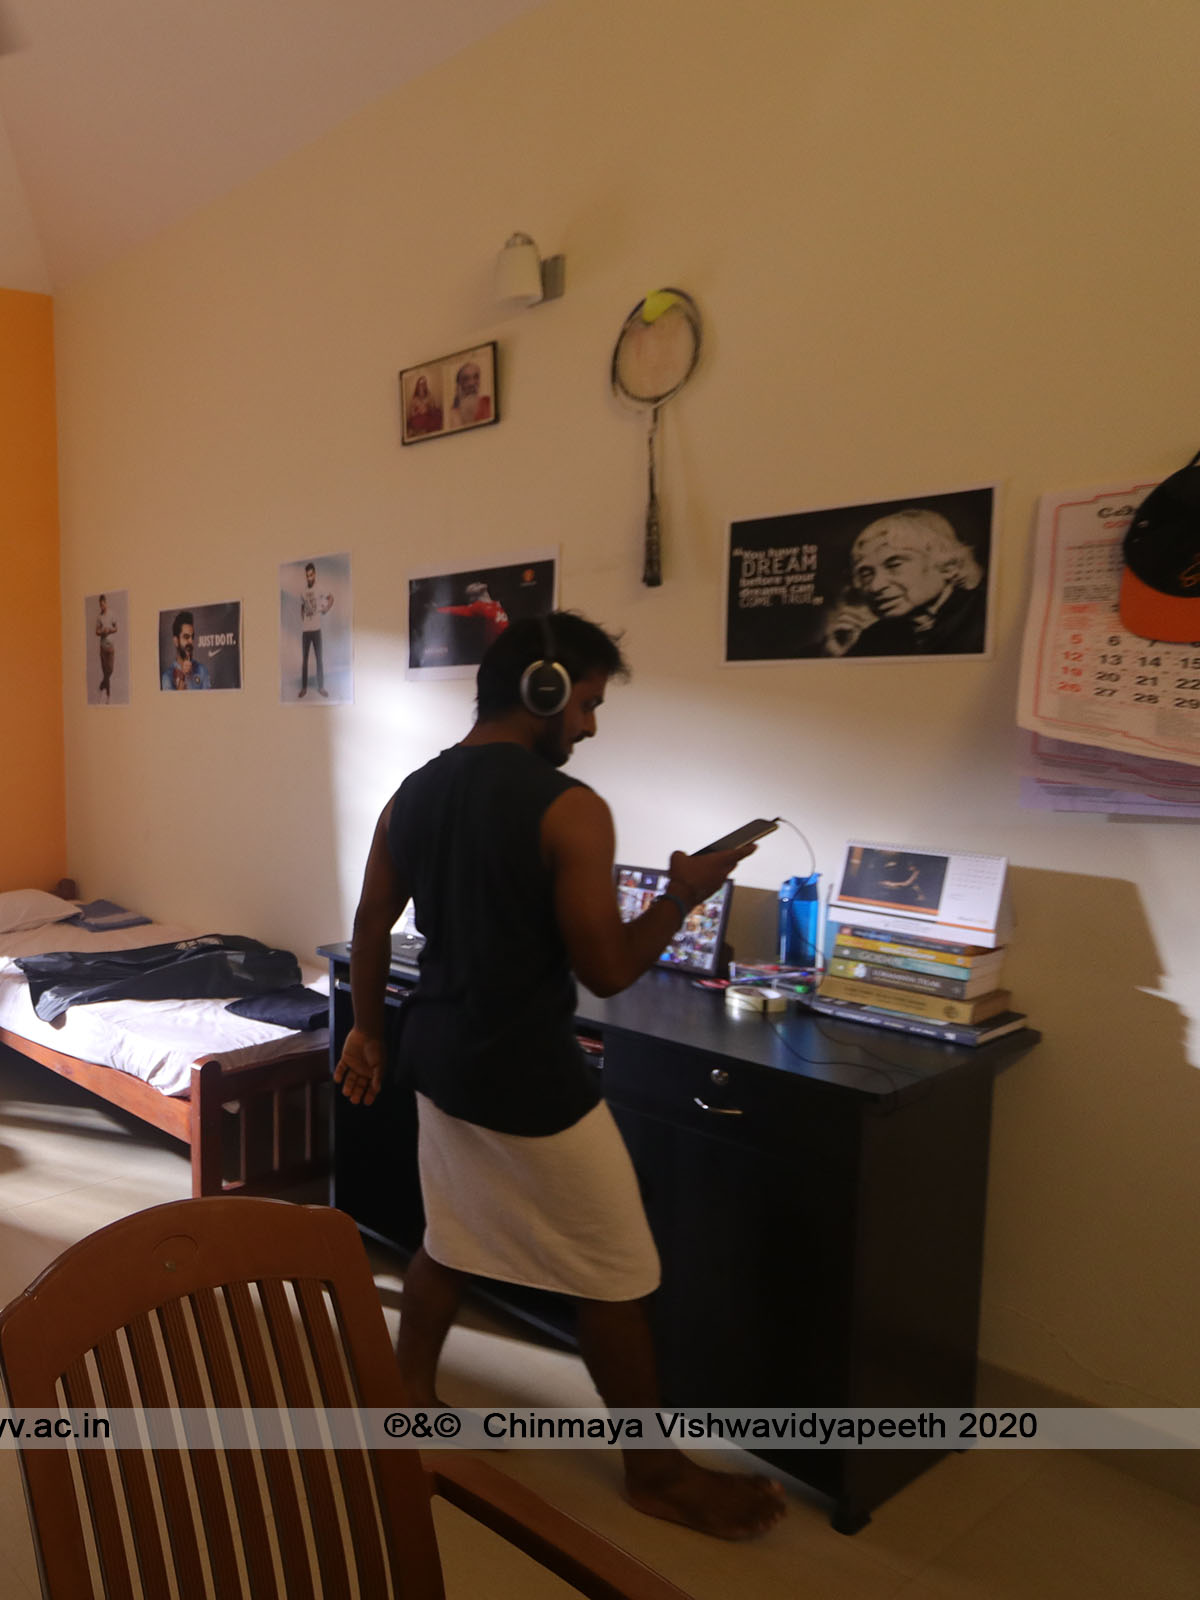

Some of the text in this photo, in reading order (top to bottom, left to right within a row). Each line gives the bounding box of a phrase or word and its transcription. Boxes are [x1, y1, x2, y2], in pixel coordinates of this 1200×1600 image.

[741, 554, 818, 578] DREAM
[198, 635, 215, 647] JUST
[215, 633, 226, 646] DO
[1071, 633, 1083, 645] 5
[1108, 635, 1121, 647] 6
[1063, 651, 1084, 662] 12
[1099, 654, 1122, 666] 13
[1138, 656, 1161, 668] 14
[1096, 671, 1120, 682] 20
[1135, 675, 1159, 687] 21
[1175, 678, 1200, 690] 22
[1093, 687, 1118, 697] 27
[1133, 693, 1159, 704] 28
[1174, 697, 1200, 709] 29
